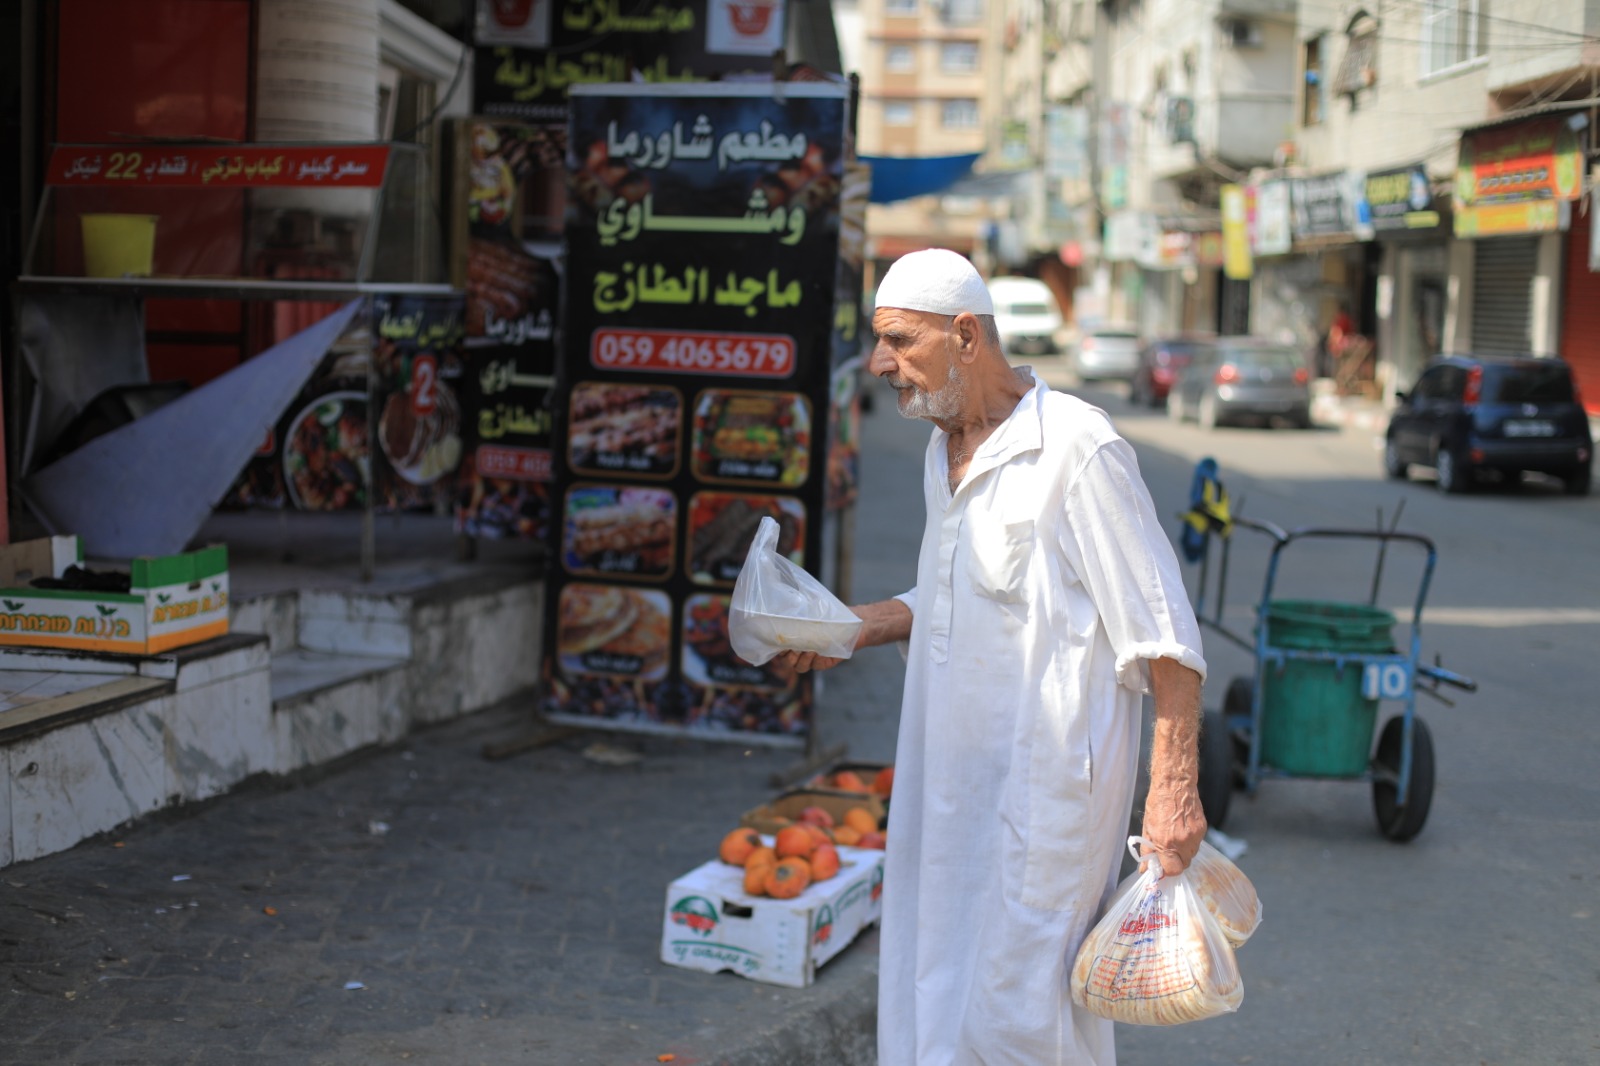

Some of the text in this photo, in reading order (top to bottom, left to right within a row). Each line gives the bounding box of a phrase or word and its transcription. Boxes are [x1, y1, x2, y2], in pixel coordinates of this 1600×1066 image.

[607, 114, 807, 171] مطعم شاورما
[104, 150, 144, 180] 22
[157, 154, 188, 176] فقط
[332, 159, 369, 181] سعر
[593, 261, 802, 317] ماجد الطازج
[598, 334, 788, 370] 059 4065679
[415, 361, 434, 406] 2
[74, 614, 131, 638] בננות
[1365, 663, 1408, 699] 10
